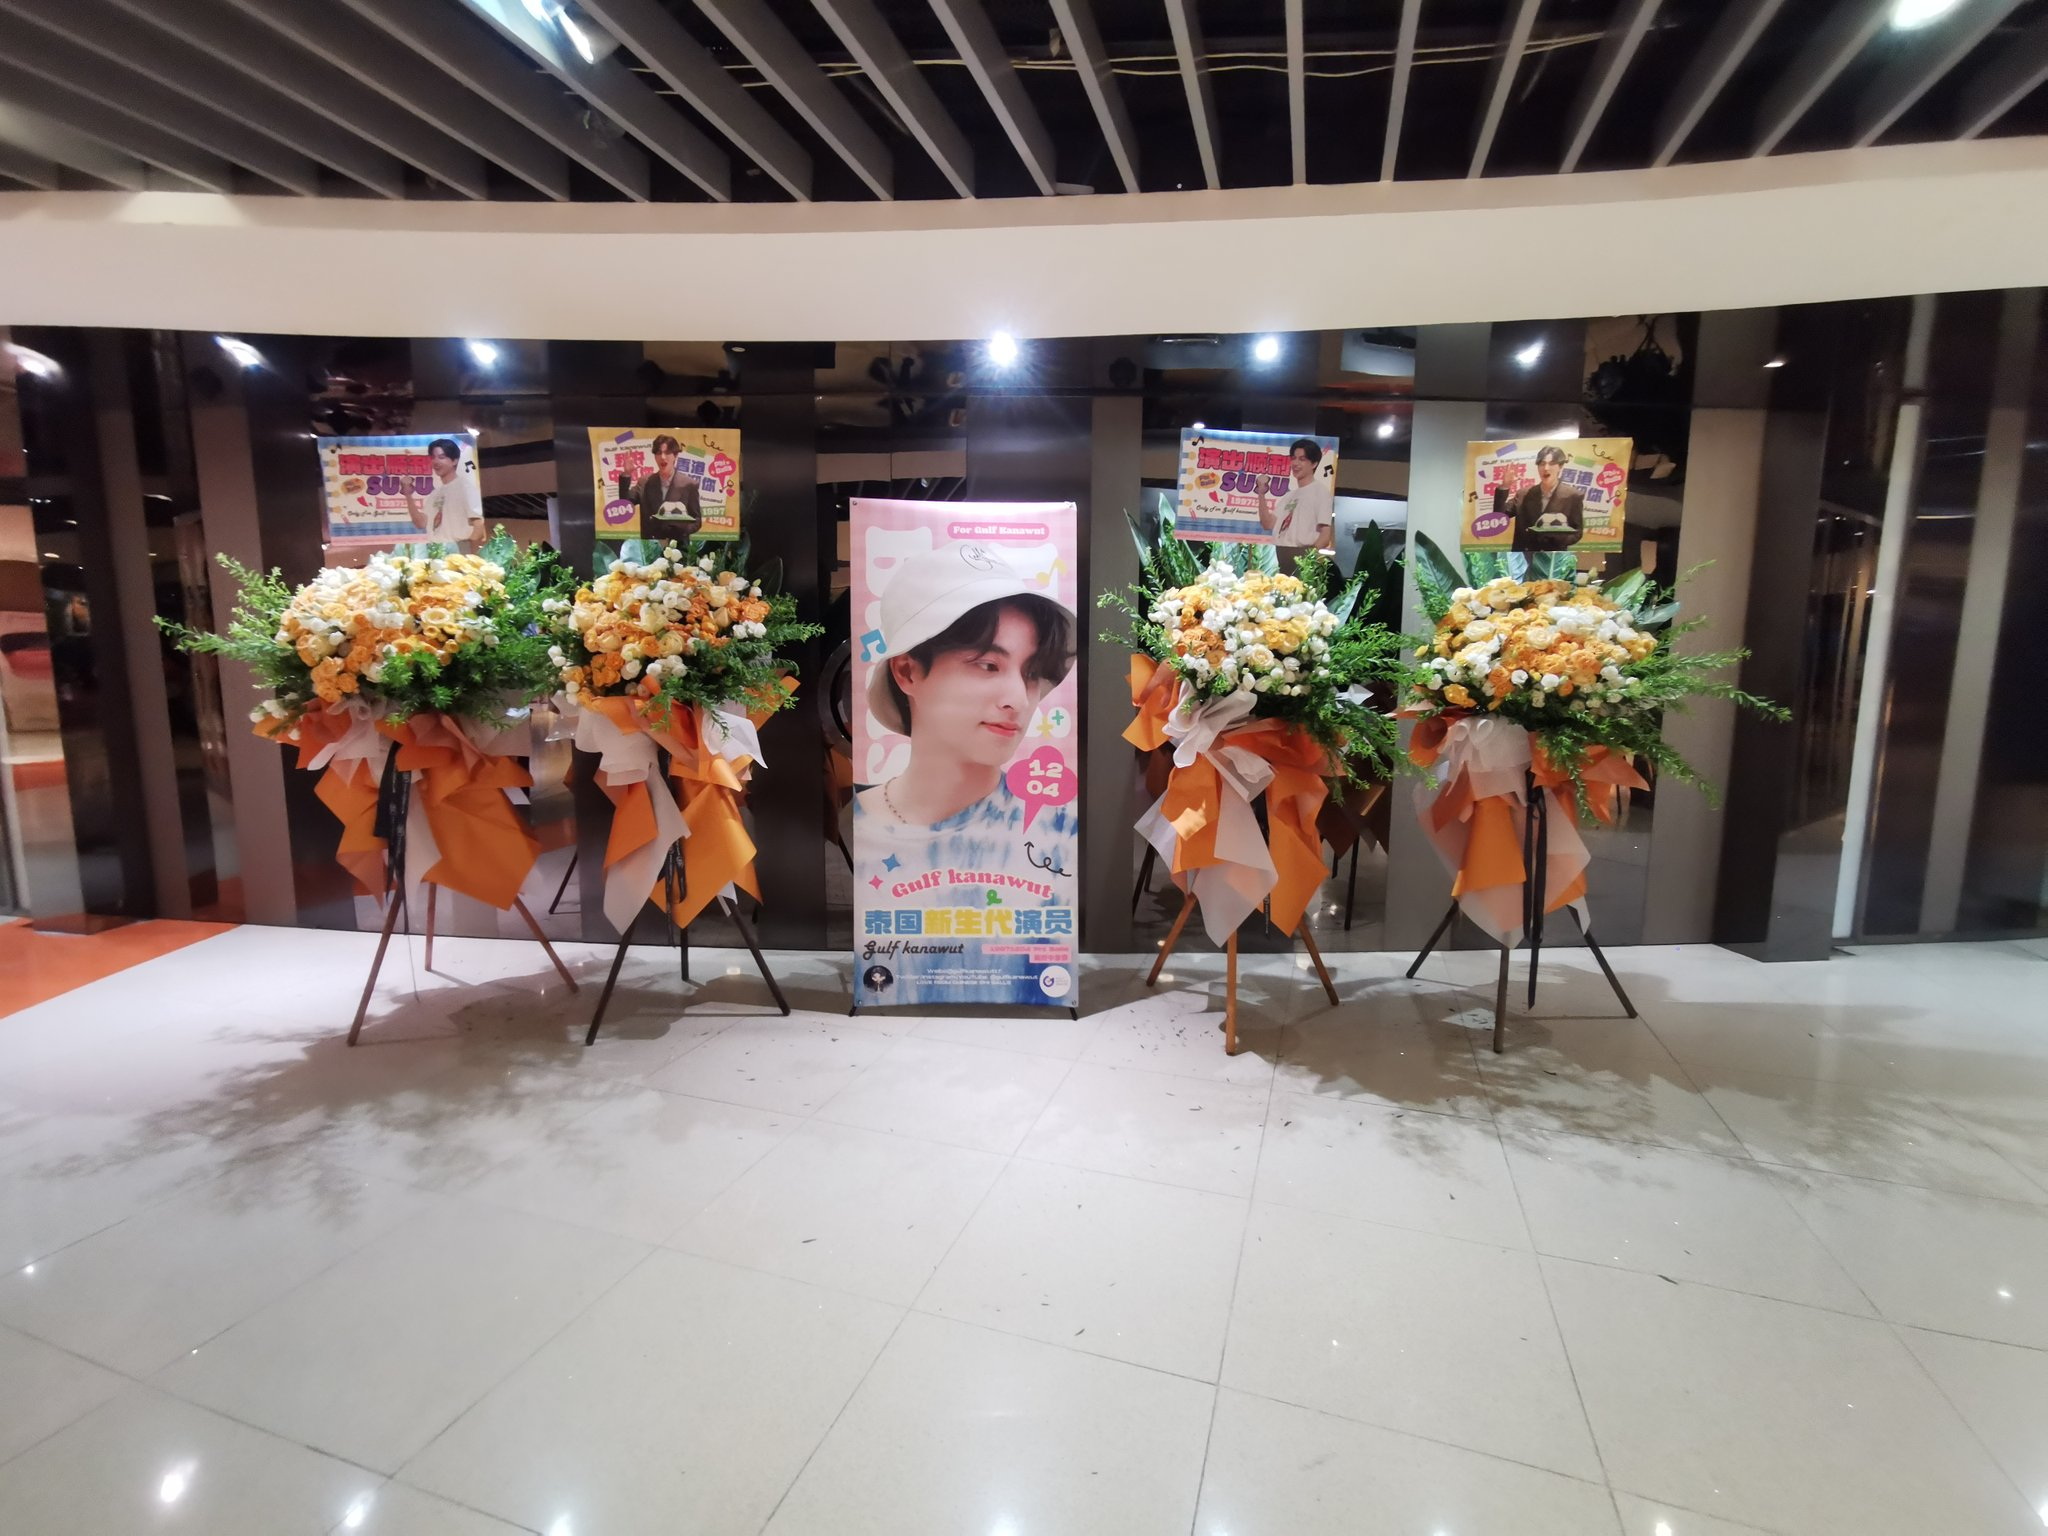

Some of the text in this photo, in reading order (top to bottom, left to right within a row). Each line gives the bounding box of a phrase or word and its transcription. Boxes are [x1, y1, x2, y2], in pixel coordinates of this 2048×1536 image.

[677, 457, 705, 475] 香港
[1197, 447, 1291, 476] 演出顺利
[1561, 468, 1594, 486] 香港
[607, 504, 633, 518] 1204
[953, 526, 1046, 535] For Gulf Kanawut
[1475, 516, 1508, 531] 1204
[1028, 759, 1064, 779] 12
[1026, 780, 1060, 798] 04
[891, 868, 1054, 899] Gulf kanawut
[864, 909, 1073, 935] 泰国新生代演员
[862, 940, 965, 961] Gulf kanawut
